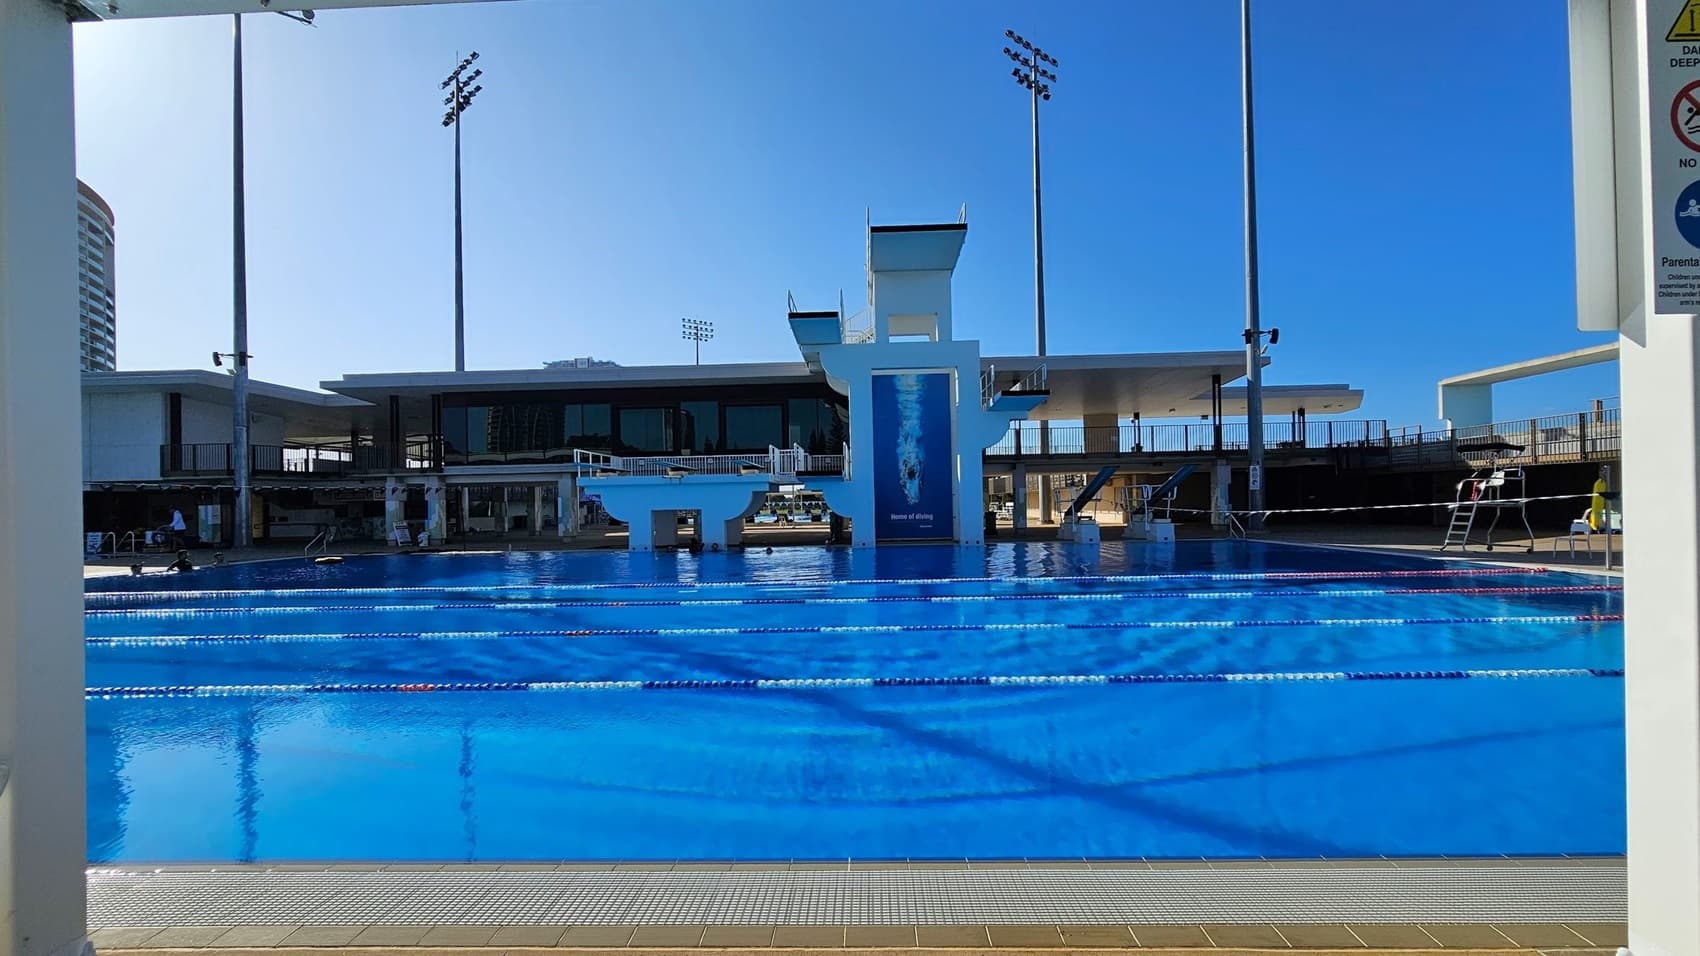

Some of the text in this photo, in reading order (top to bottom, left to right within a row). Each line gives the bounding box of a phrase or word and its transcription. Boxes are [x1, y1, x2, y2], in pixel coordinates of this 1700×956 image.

[1670, 58, 1700, 67] DEEP
[1679, 158, 1697, 168] NO
[908, 512, 915, 520] of
[915, 512, 933, 520] diving
